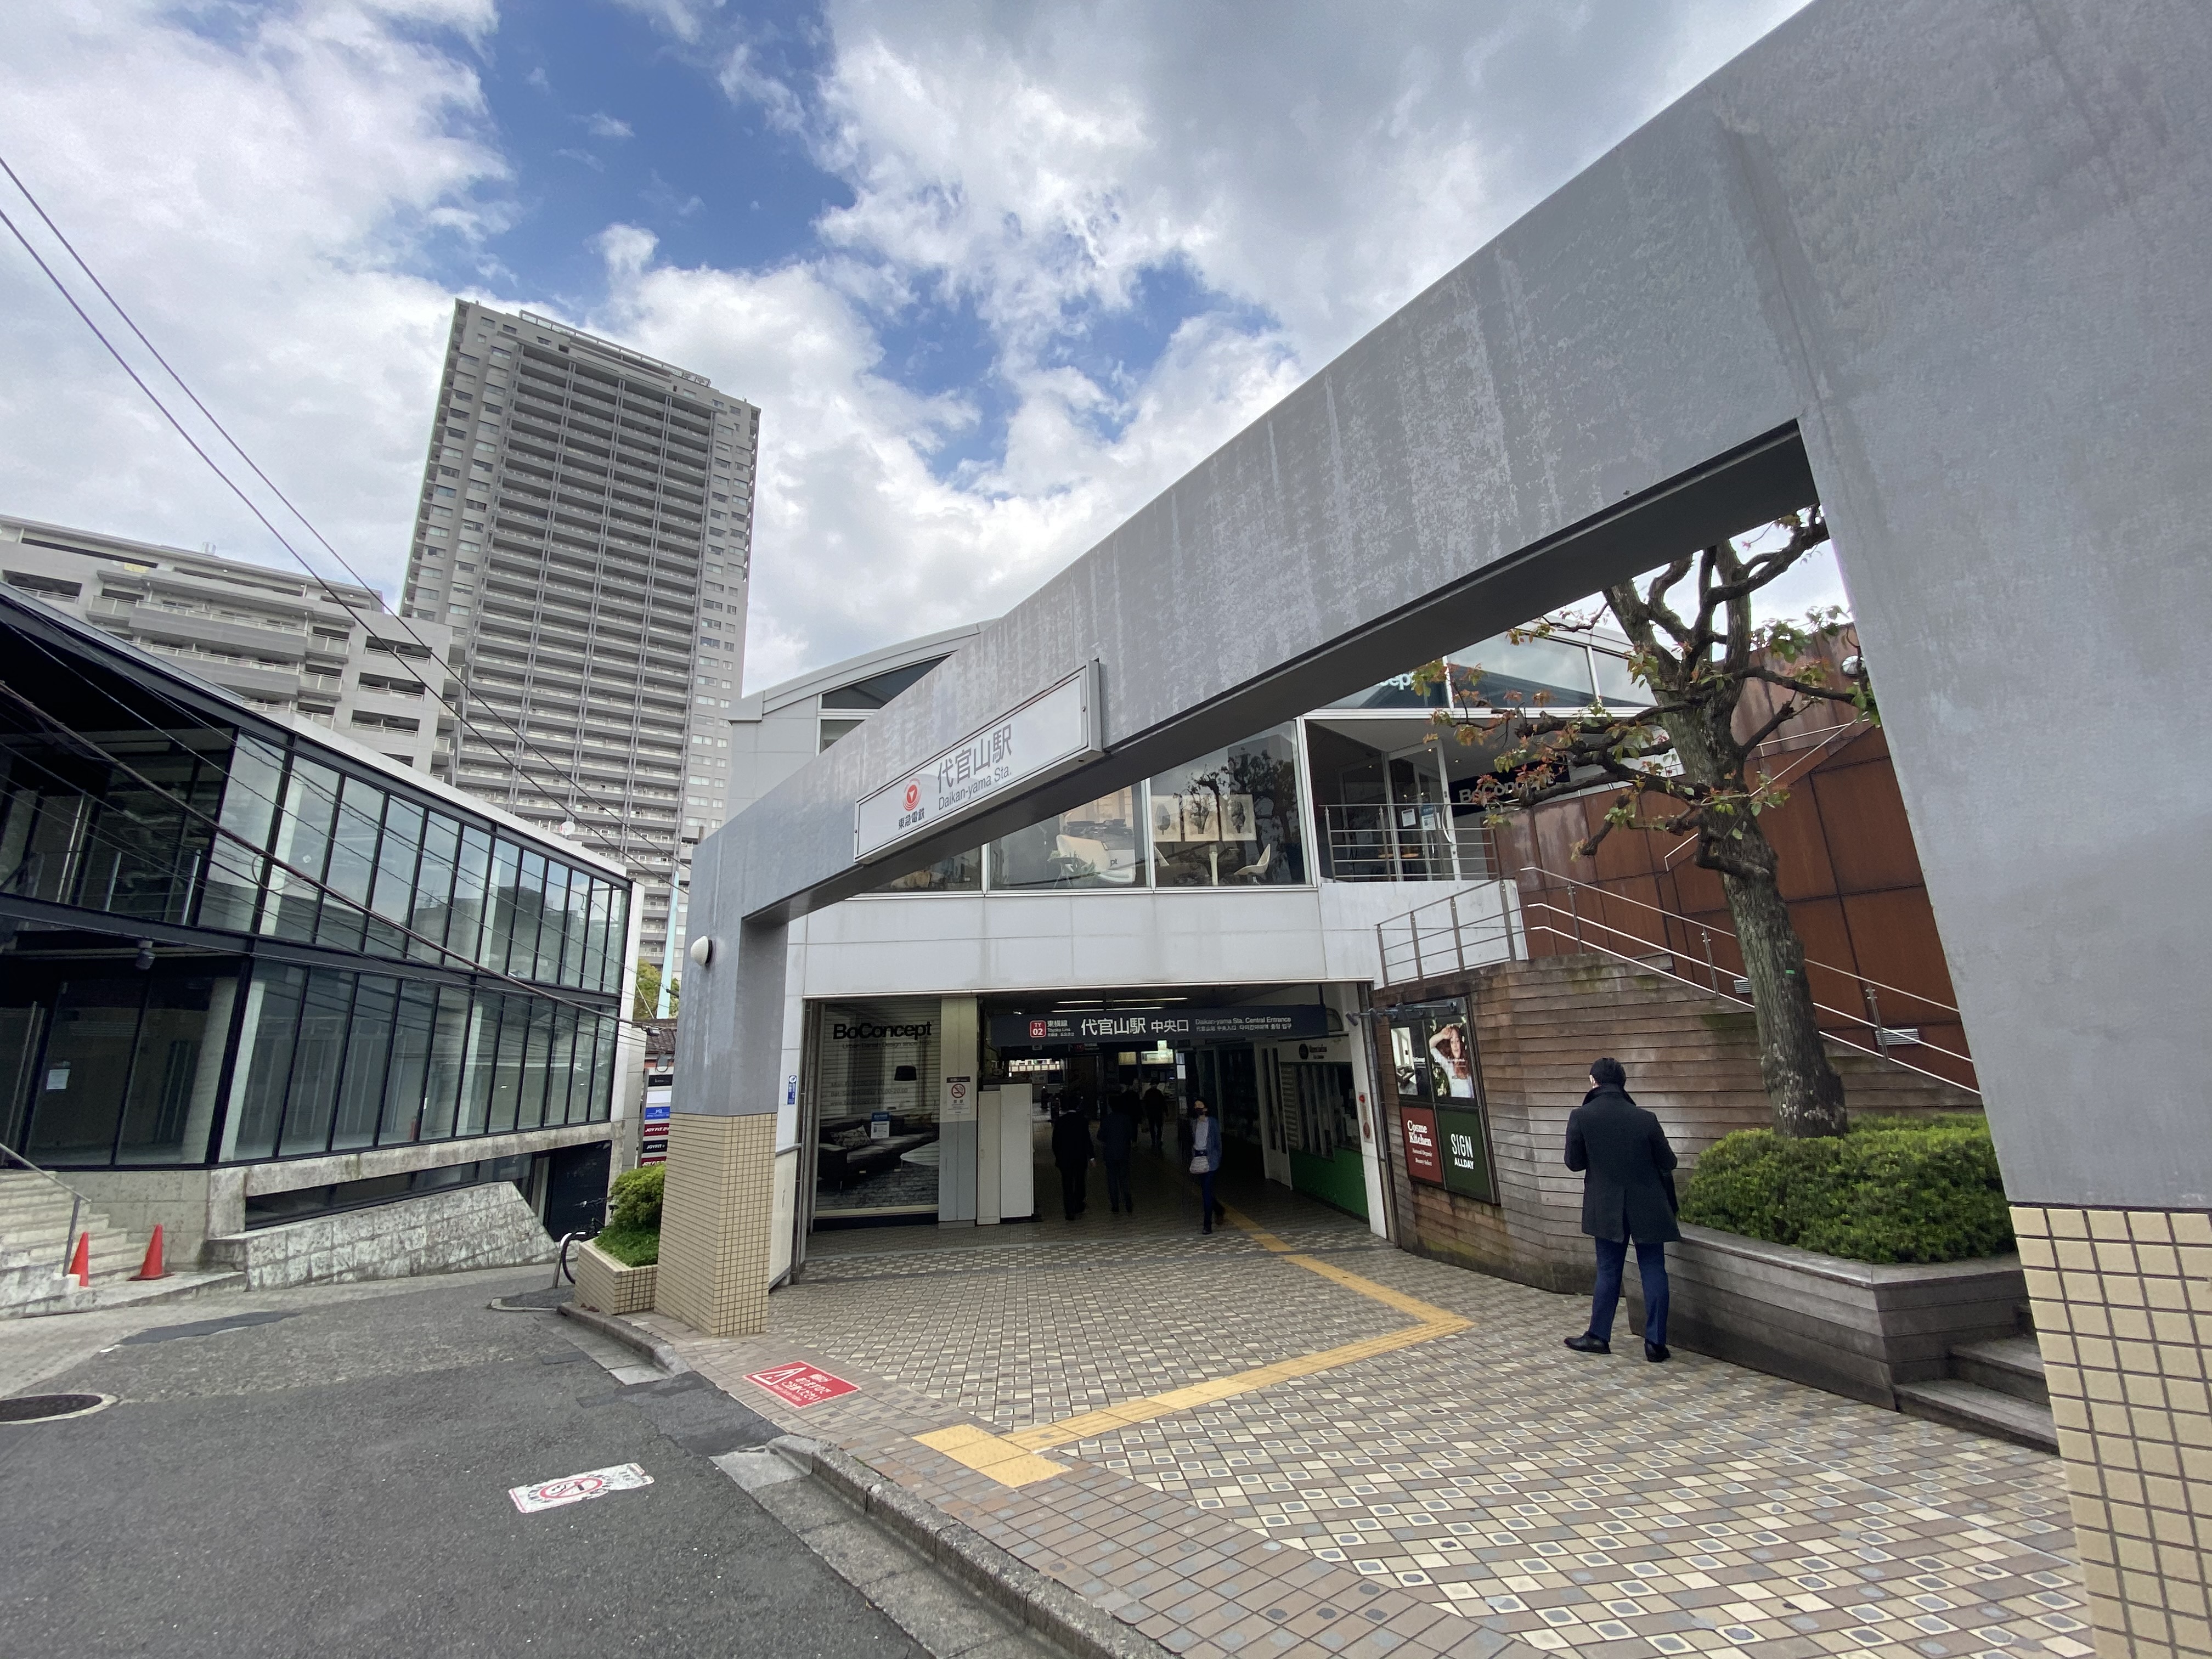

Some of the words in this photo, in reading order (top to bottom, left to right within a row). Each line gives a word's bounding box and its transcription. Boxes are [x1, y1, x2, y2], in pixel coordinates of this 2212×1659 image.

[938, 724, 1012, 793] 代官山駅
[939, 777, 992, 810] Daikan-yama
[994, 766, 1012, 783] Sta.
[898, 808, 925, 830] 東急電鉄
[833, 1021, 932, 1040] BoConcept
[1081, 1017, 1147, 1036] 代官山駅
[1150, 1019, 1189, 1034] 中央口
[1407, 1120, 1427, 1133] Cosme
[1408, 1132, 1432, 1147] Kitchen
[1451, 1133, 1473, 1158] SIGN
[1454, 1158, 1474, 1169] ALLDAY
